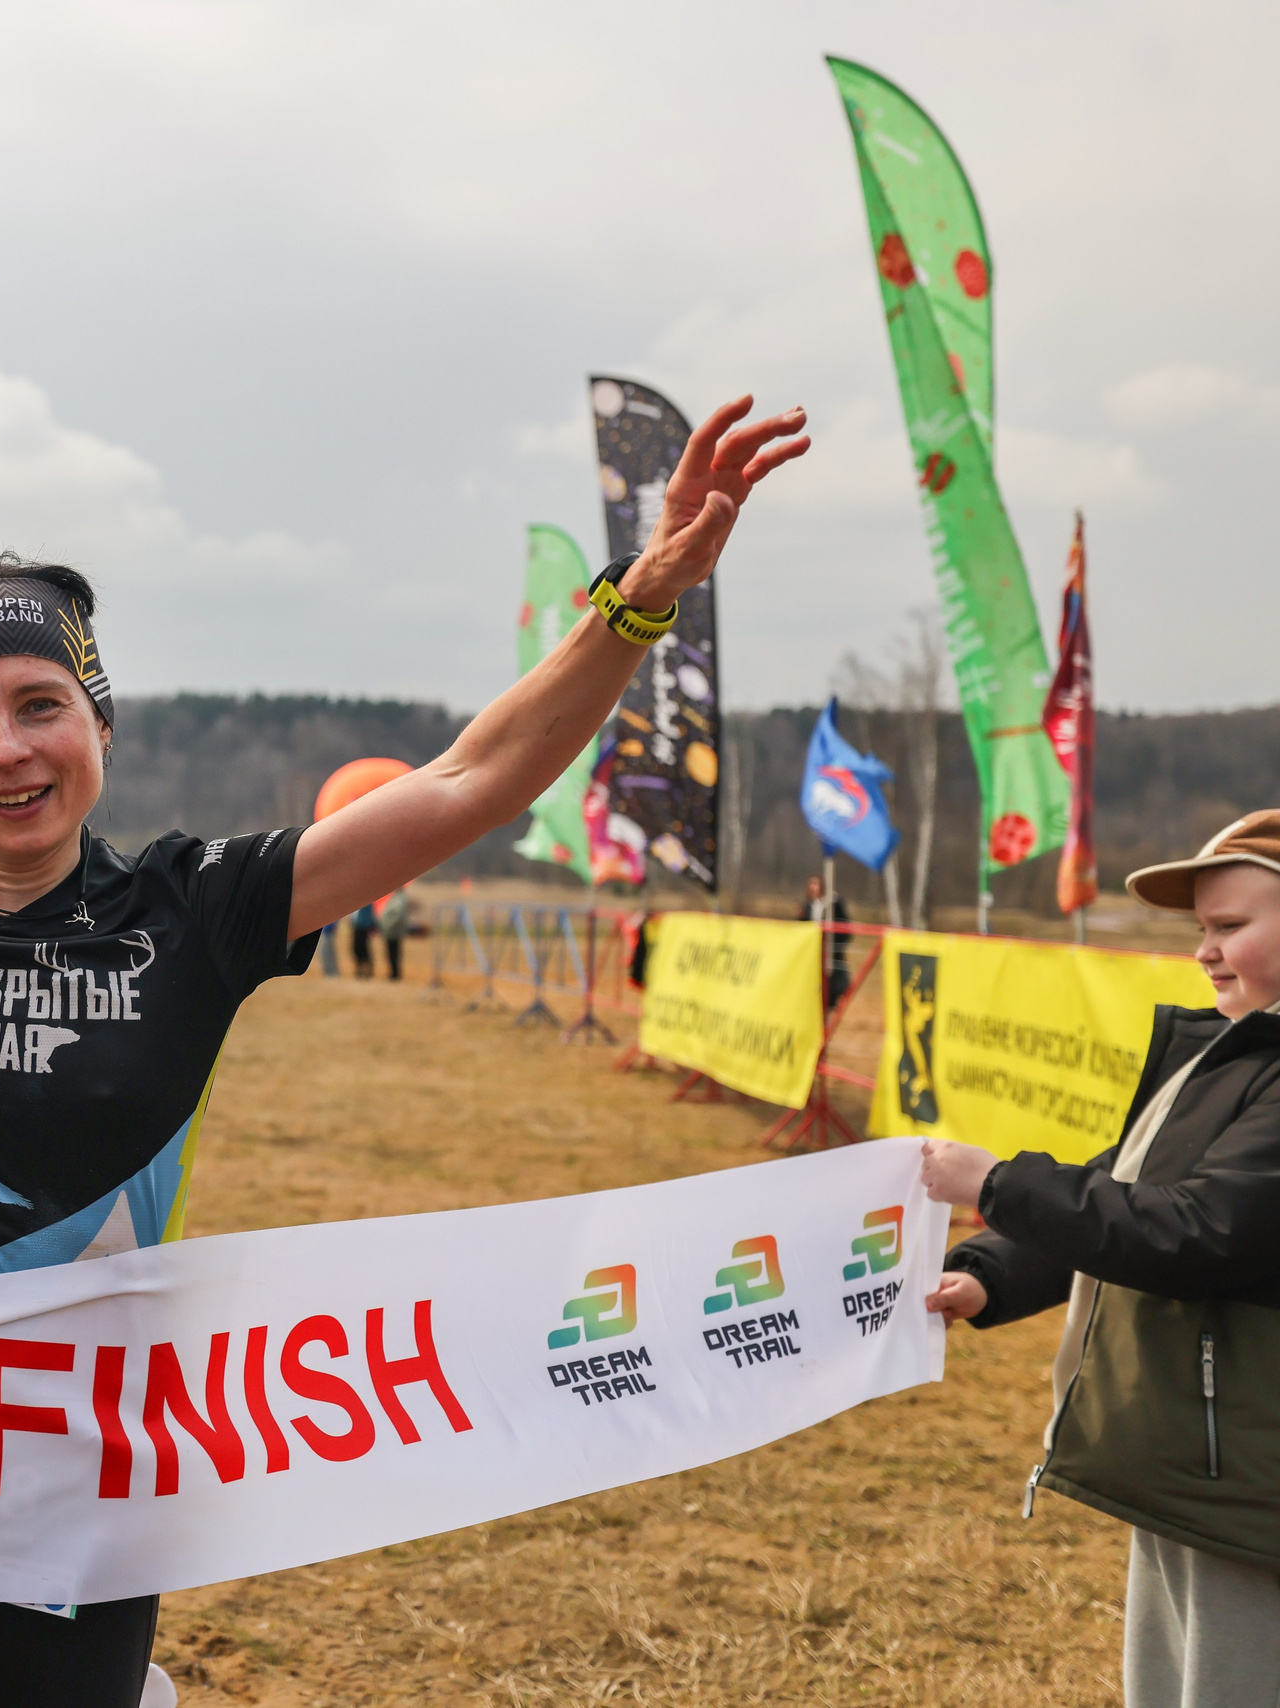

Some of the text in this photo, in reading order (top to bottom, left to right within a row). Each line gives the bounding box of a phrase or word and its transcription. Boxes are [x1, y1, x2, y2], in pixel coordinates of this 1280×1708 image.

[703, 1309, 800, 1351] DREAM
[547, 1346, 653, 1388] DREAM
[725, 1335, 801, 1369] TRAIL
[572, 1373, 657, 1406] TRAIL
